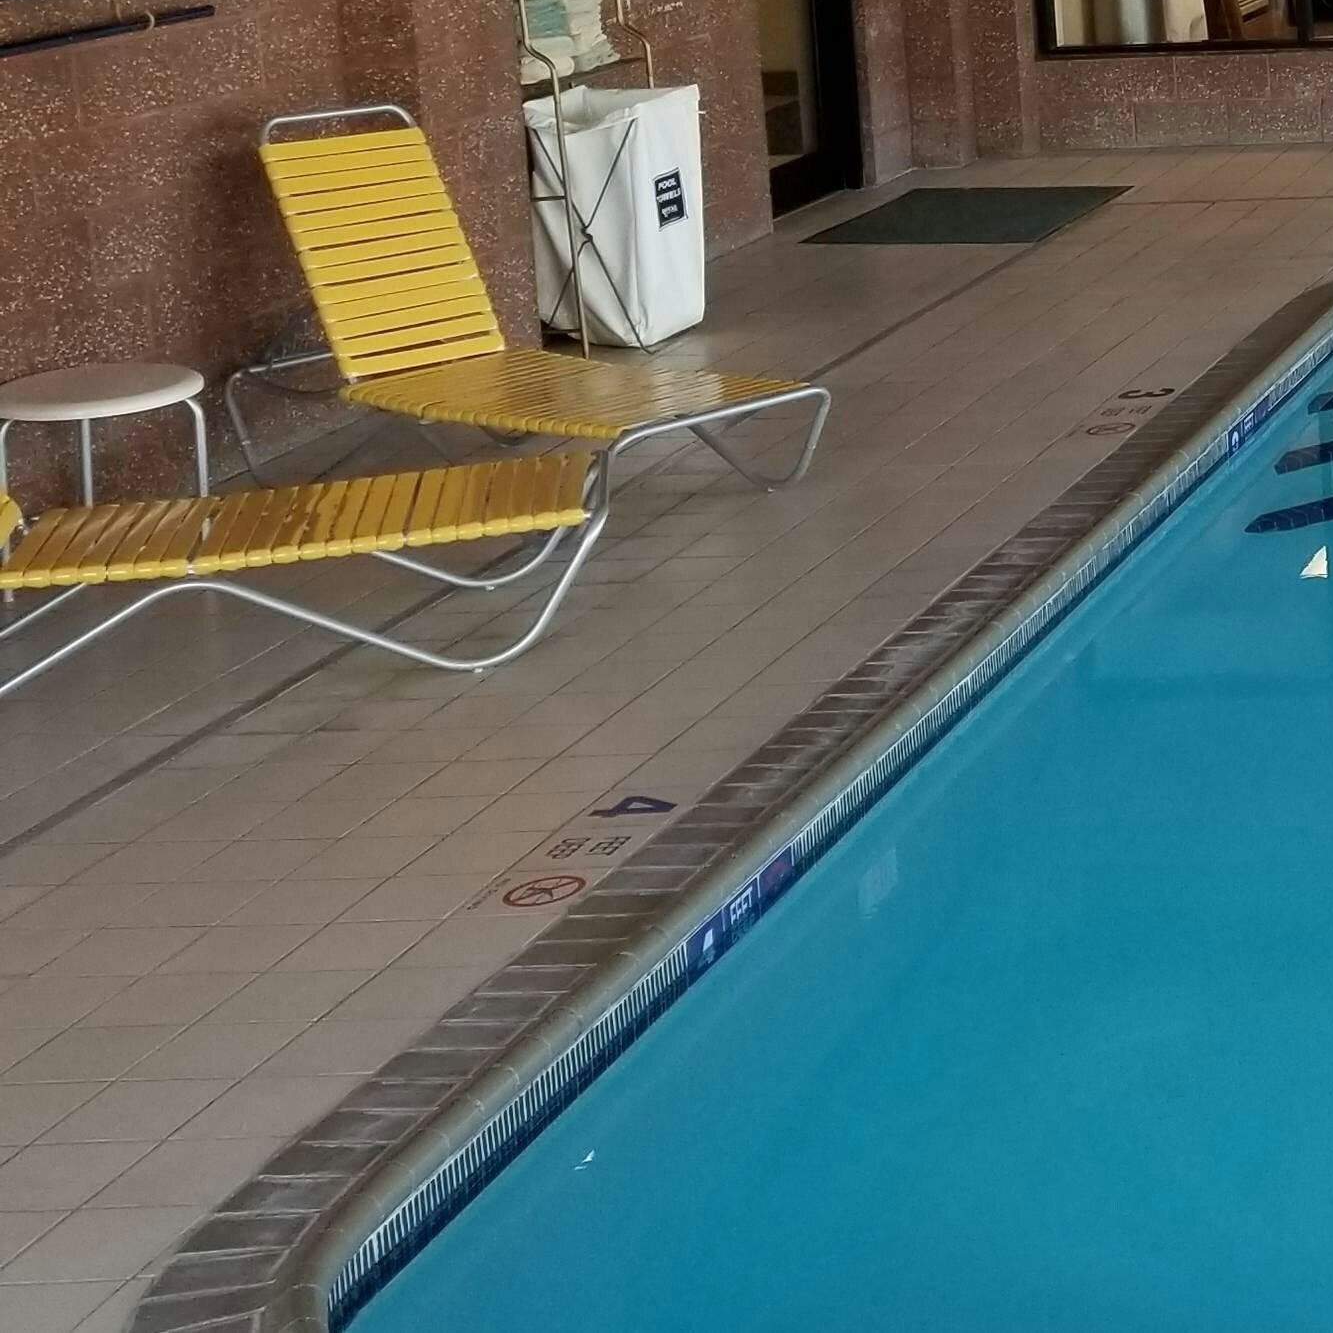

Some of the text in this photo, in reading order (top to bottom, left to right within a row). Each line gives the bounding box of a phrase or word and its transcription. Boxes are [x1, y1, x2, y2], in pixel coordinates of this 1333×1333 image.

[657, 177, 677, 191] POOL
[656, 187, 681, 203] TOWELS
[1117, 388, 1175, 398] 3
[587, 795, 679, 818] 4
[585, 836, 632, 856] FEET
